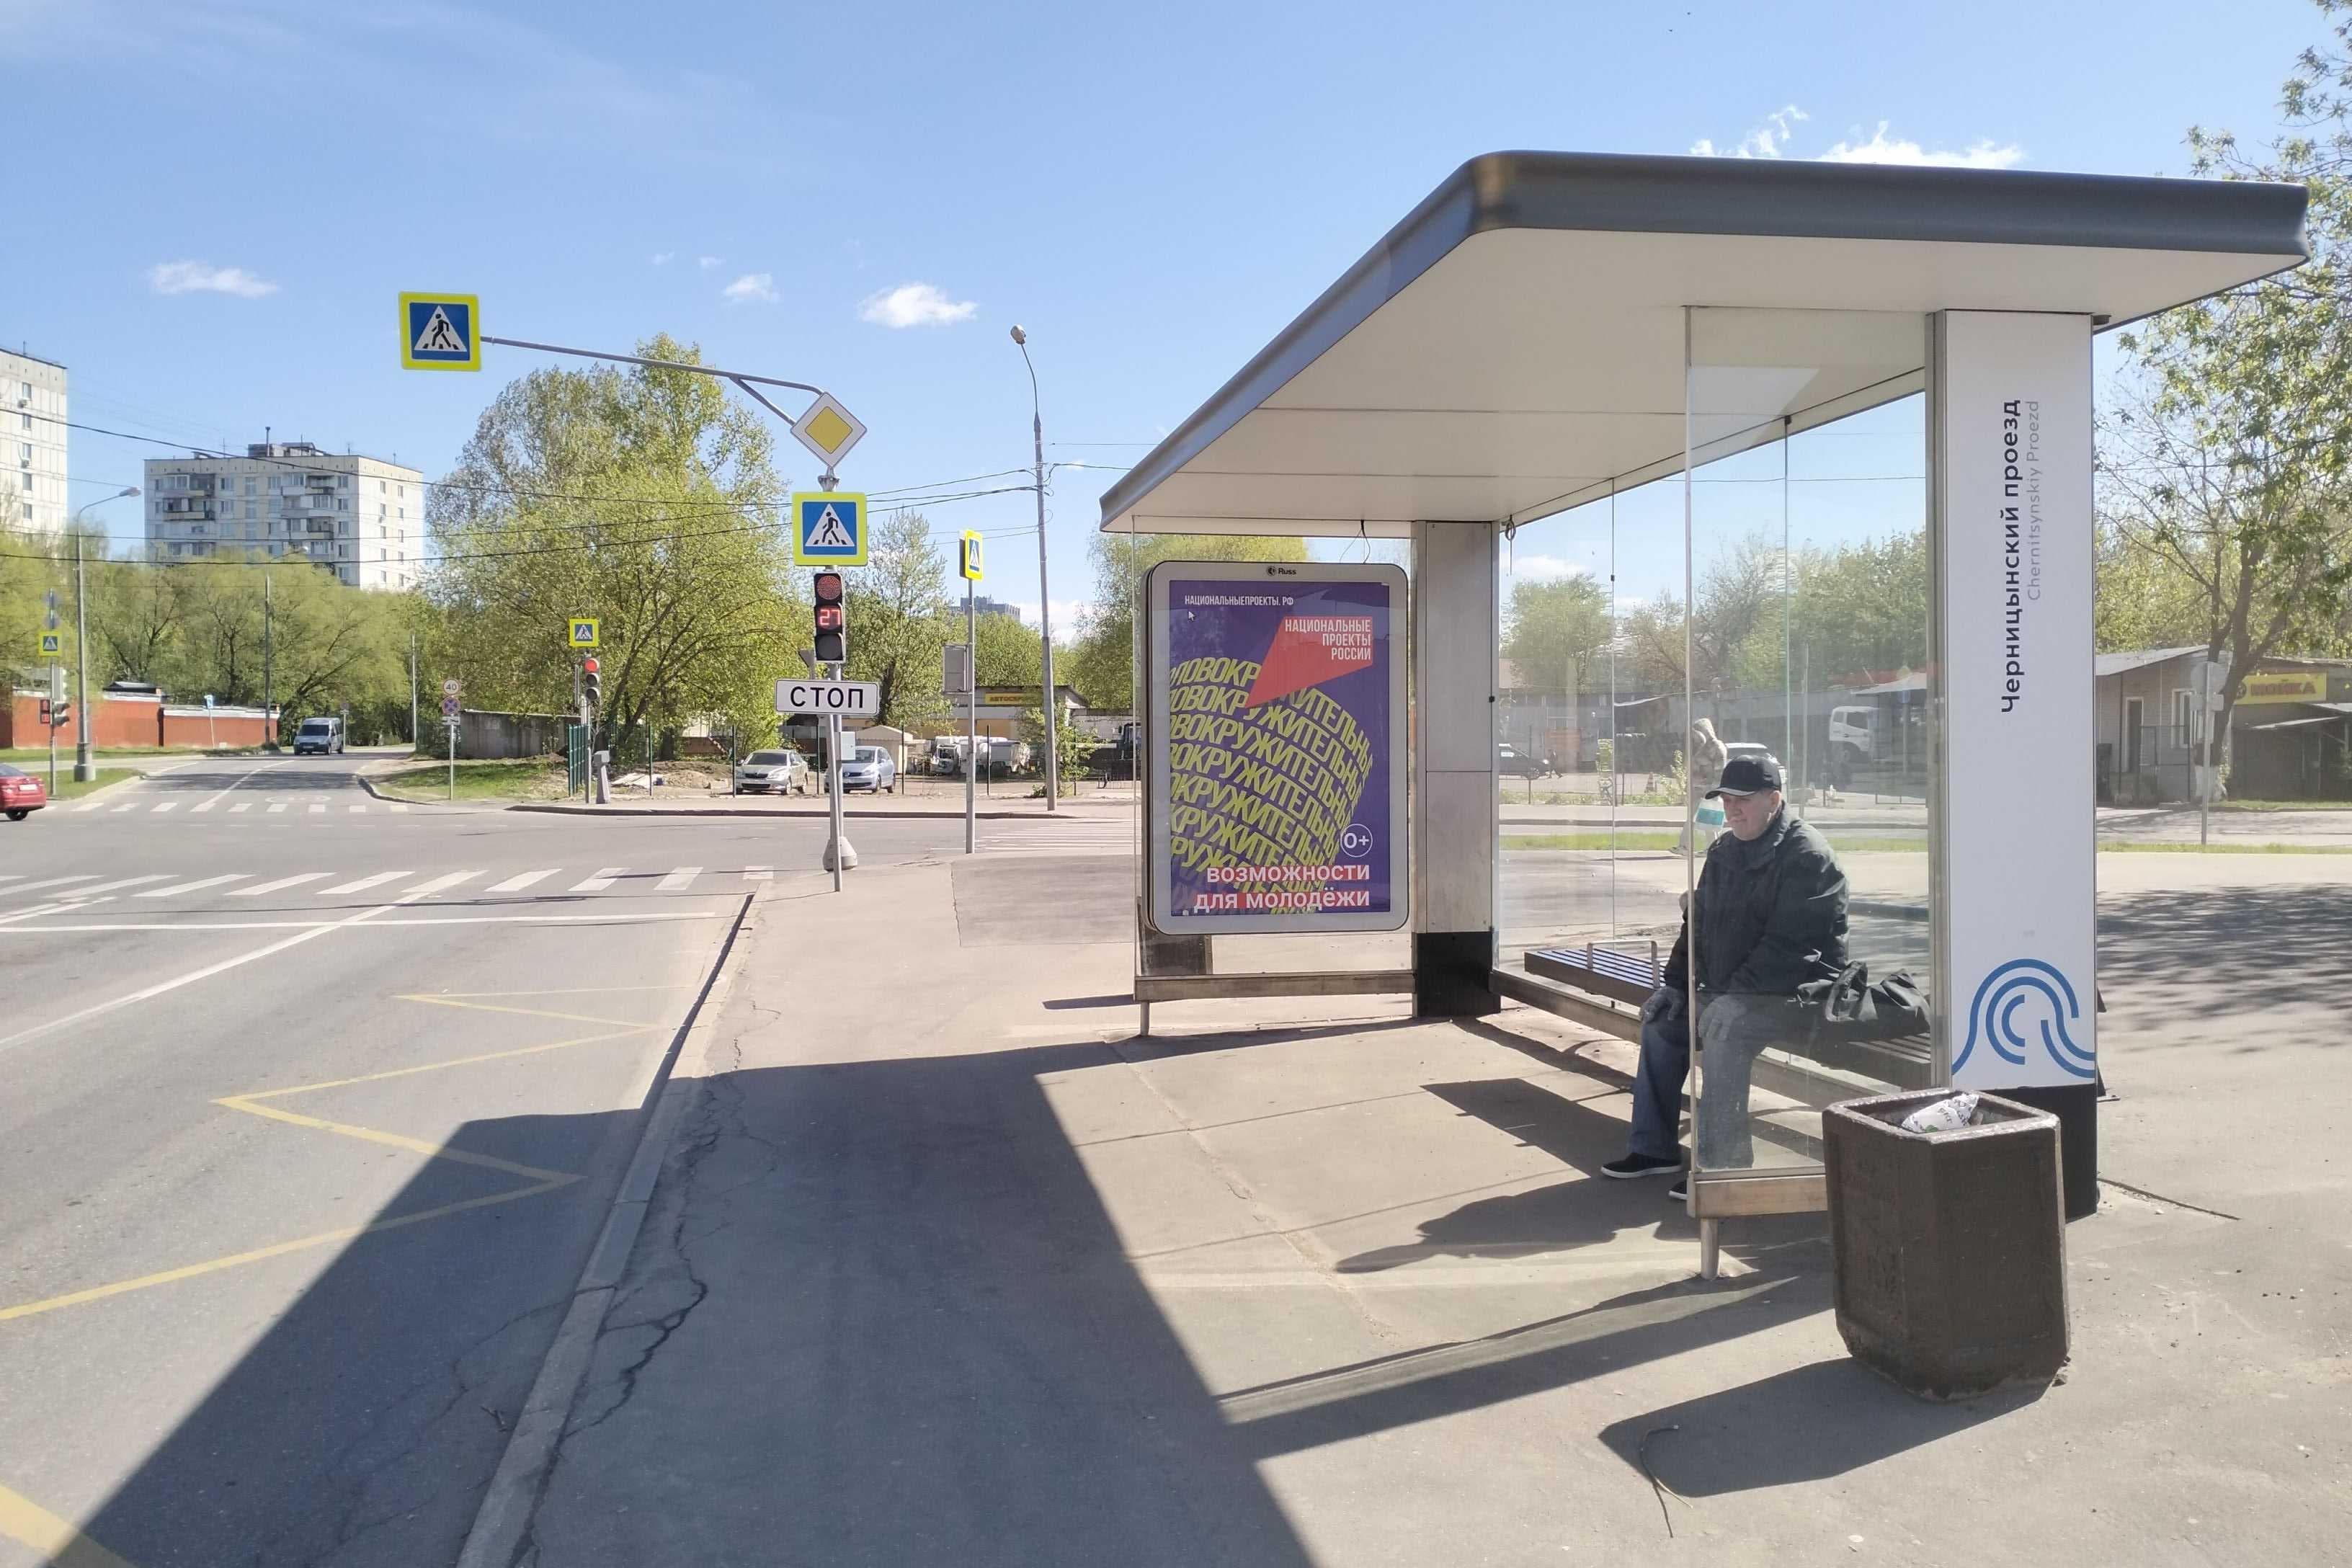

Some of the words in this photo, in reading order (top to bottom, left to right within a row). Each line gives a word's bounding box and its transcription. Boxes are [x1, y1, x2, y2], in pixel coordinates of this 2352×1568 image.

[2026, 401, 2040, 461] Proezd
[2003, 400, 2023, 497] проезд
[2026, 468, 2044, 600] Chernitsynskiy
[819, 608, 842, 626] 27
[2000, 507, 2025, 713] Черницынский
[1285, 619, 1371, 633] НАЦИОНАЛЬНЫЕ
[1322, 633, 1371, 646] ПРОЕКТЫ
[1331, 647, 1372, 660] РОССИИ
[790, 686, 863, 709] СТОП
[1343, 832, 1370, 849] 0+
